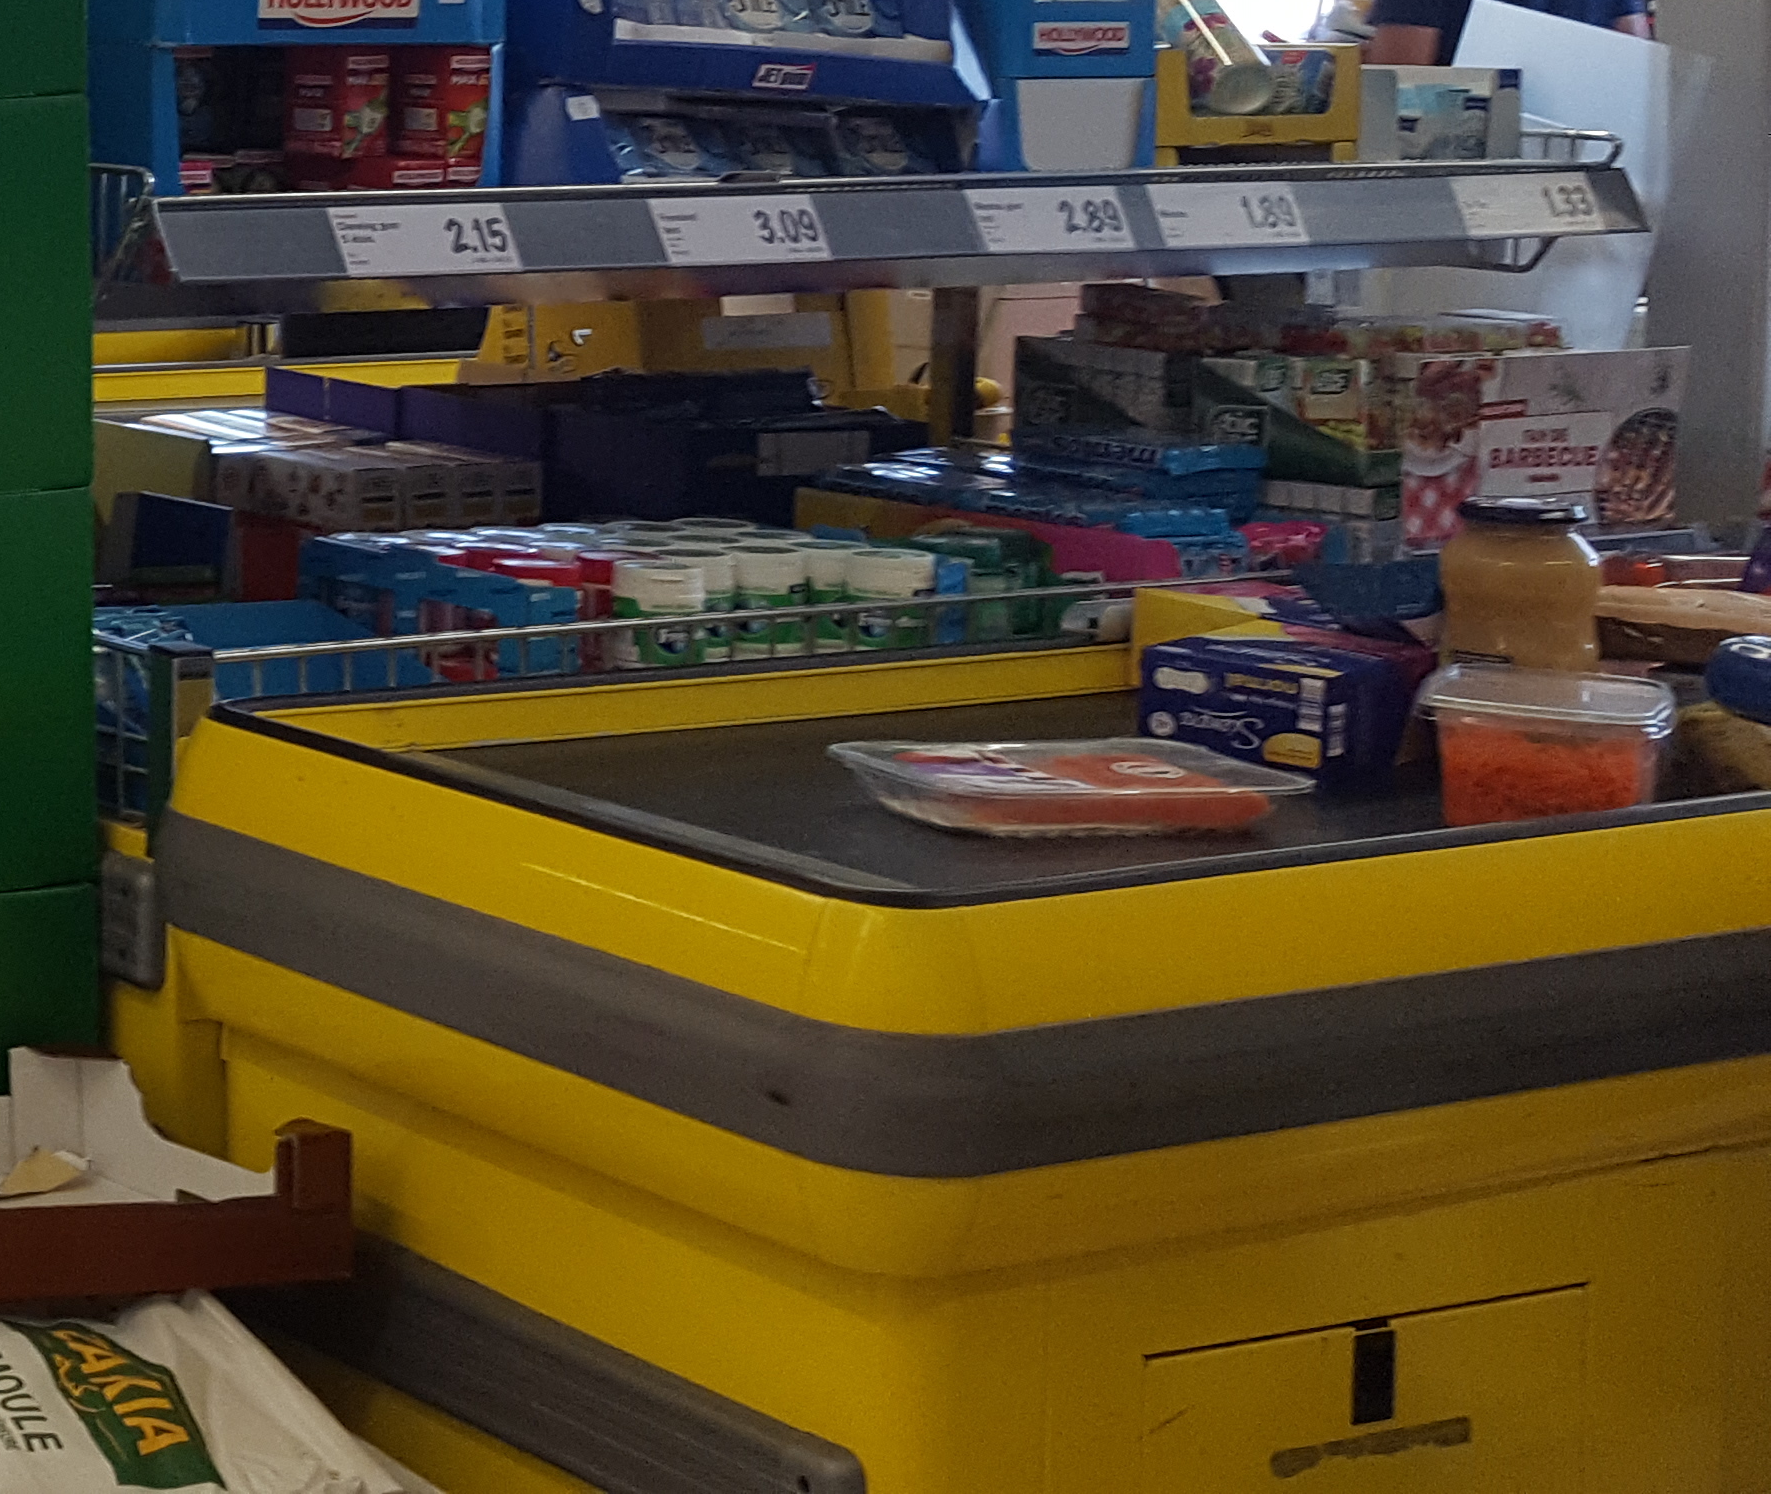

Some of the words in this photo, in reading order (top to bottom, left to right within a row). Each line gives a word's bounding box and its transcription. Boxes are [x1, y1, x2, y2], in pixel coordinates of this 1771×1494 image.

[753, 208, 819, 245] 3.09
[1058, 197, 1123, 234] 2.89
[443, 216, 508, 254] 2.15
[1488, 444, 1599, 469] BARBECUE
[49, 1328, 191, 1457] ZAKIA
